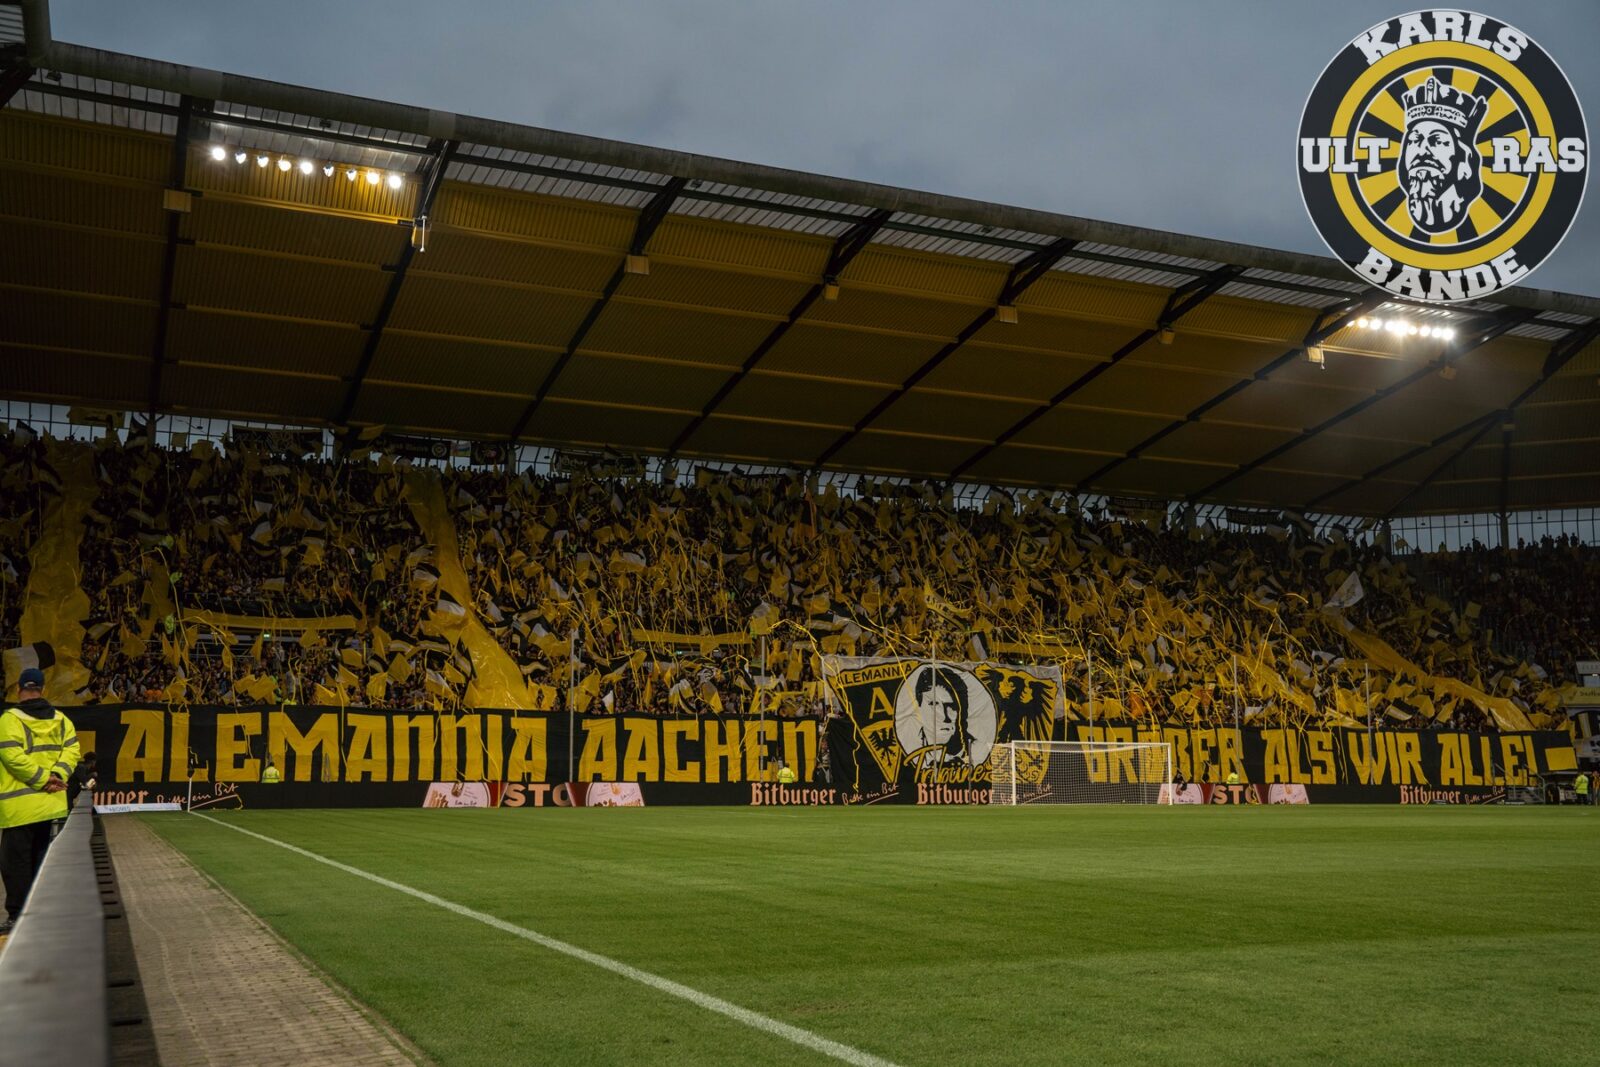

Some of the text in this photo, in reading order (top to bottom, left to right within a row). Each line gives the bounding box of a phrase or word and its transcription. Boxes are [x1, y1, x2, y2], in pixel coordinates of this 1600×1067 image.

[115, 709, 548, 783] ALEMANNIA
[578, 716, 817, 783] AACHEN
[1261, 728, 1337, 785] ALS
[1347, 731, 1428, 785] WIR
[1437, 733, 1538, 787] ALLE!
[903, 743, 986, 784] Tribüne
[214, 782, 239, 797] Bit
[750, 783, 836, 806] Bitburger
[916, 783, 995, 805] Bitburger
